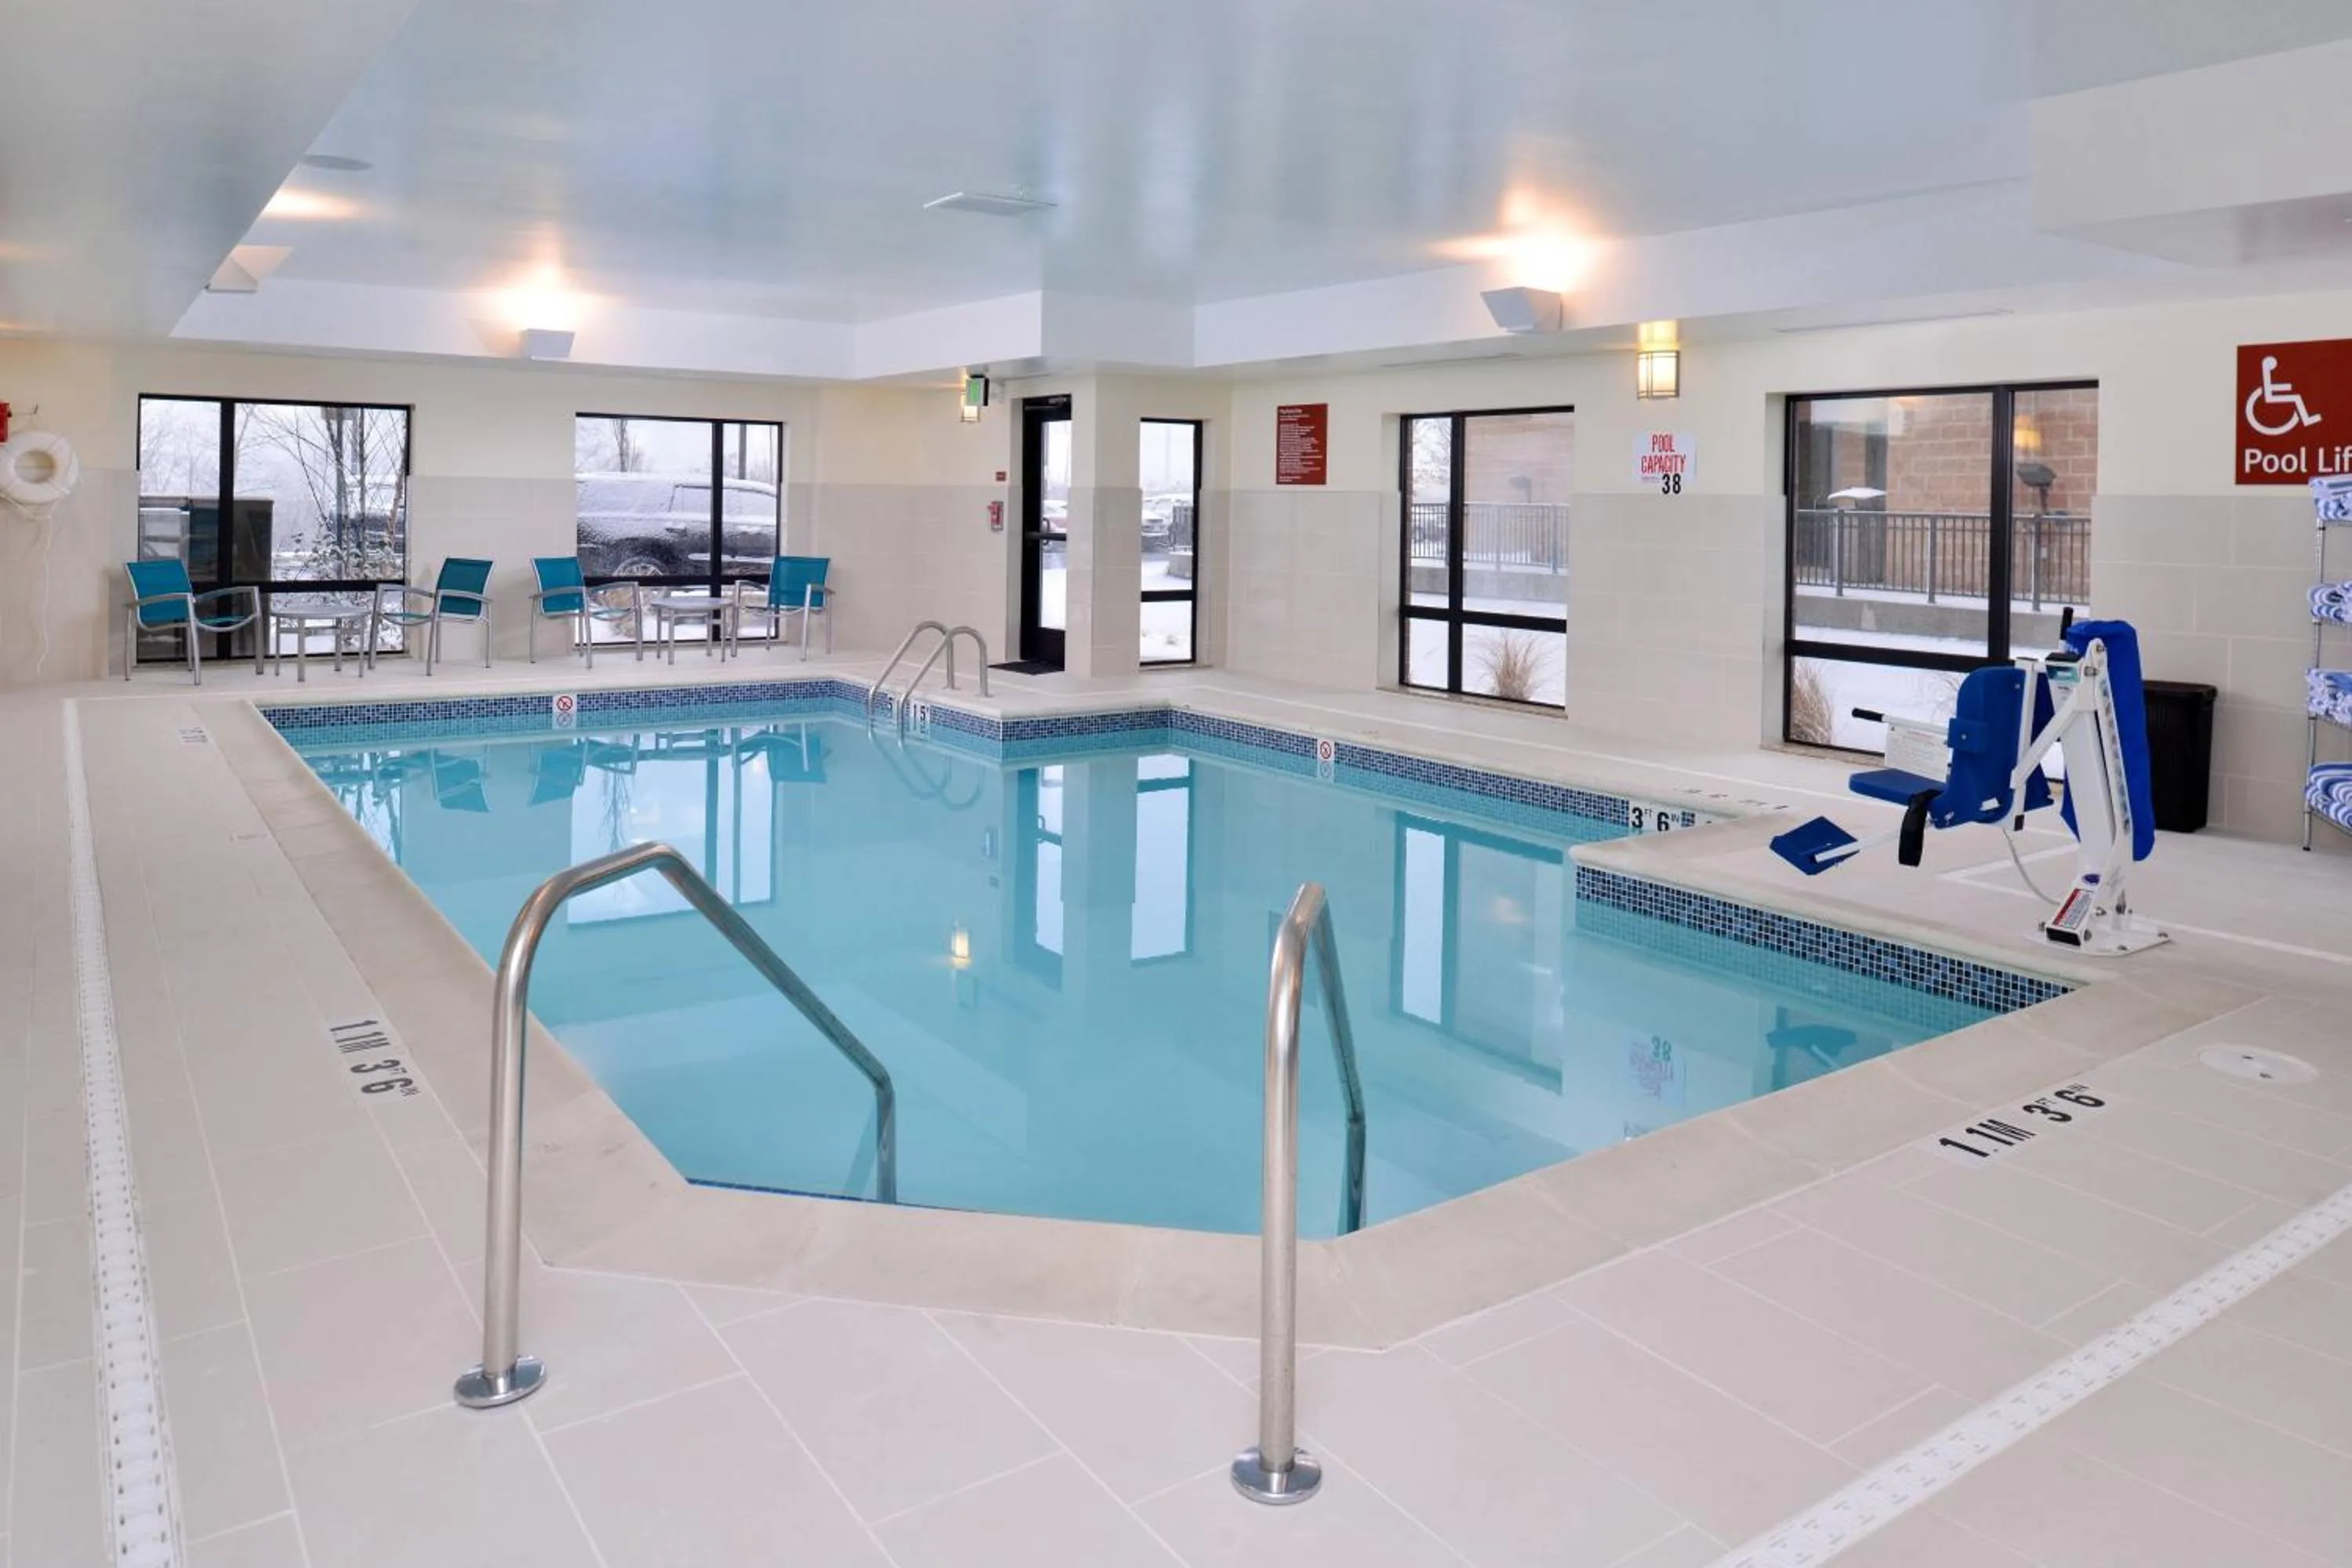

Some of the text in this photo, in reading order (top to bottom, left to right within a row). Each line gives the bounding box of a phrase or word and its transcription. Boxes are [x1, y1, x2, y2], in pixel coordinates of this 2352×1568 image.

[1652, 434, 1675, 452] POOL
[1641, 453, 1686, 474] CAPACITY
[2245, 445, 2307, 474] Pool
[1661, 473, 1682, 495] 38
